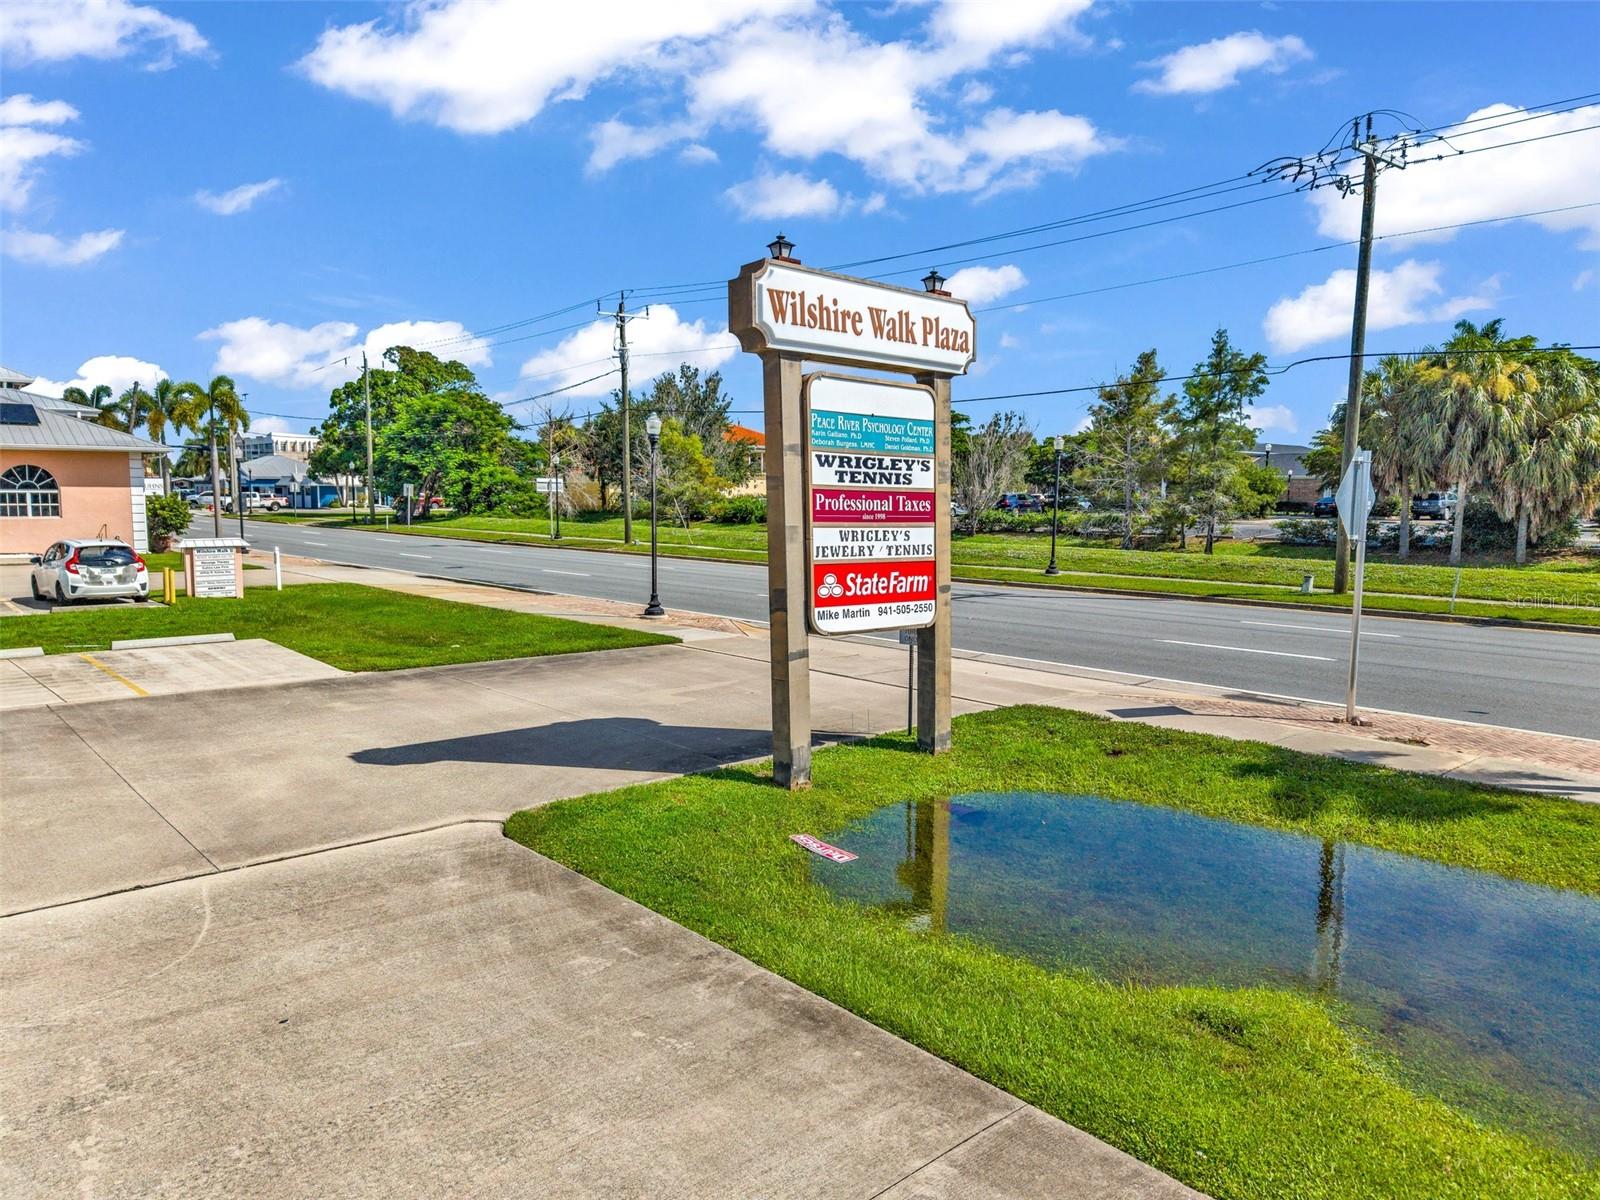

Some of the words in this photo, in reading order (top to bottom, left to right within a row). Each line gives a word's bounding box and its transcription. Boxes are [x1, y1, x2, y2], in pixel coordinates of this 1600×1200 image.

[766, 288, 863, 337] Wilshire
[867, 306, 918, 345] Walk
[921, 316, 970, 353] Plaza
[815, 454, 931, 472] WRIGLEY'S
[834, 470, 913, 486] TENNIS
[815, 493, 893, 512] Professional
[896, 495, 931, 512] Taxes
[838, 530, 911, 542] WRIGLEY'S
[816, 545, 875, 558] JEWELRY
[886, 544, 933, 556] TENNIS
[818, 610, 840, 620] Mike
[842, 608, 870, 619] Martin
[878, 603, 933, 616] 941-505-2550
